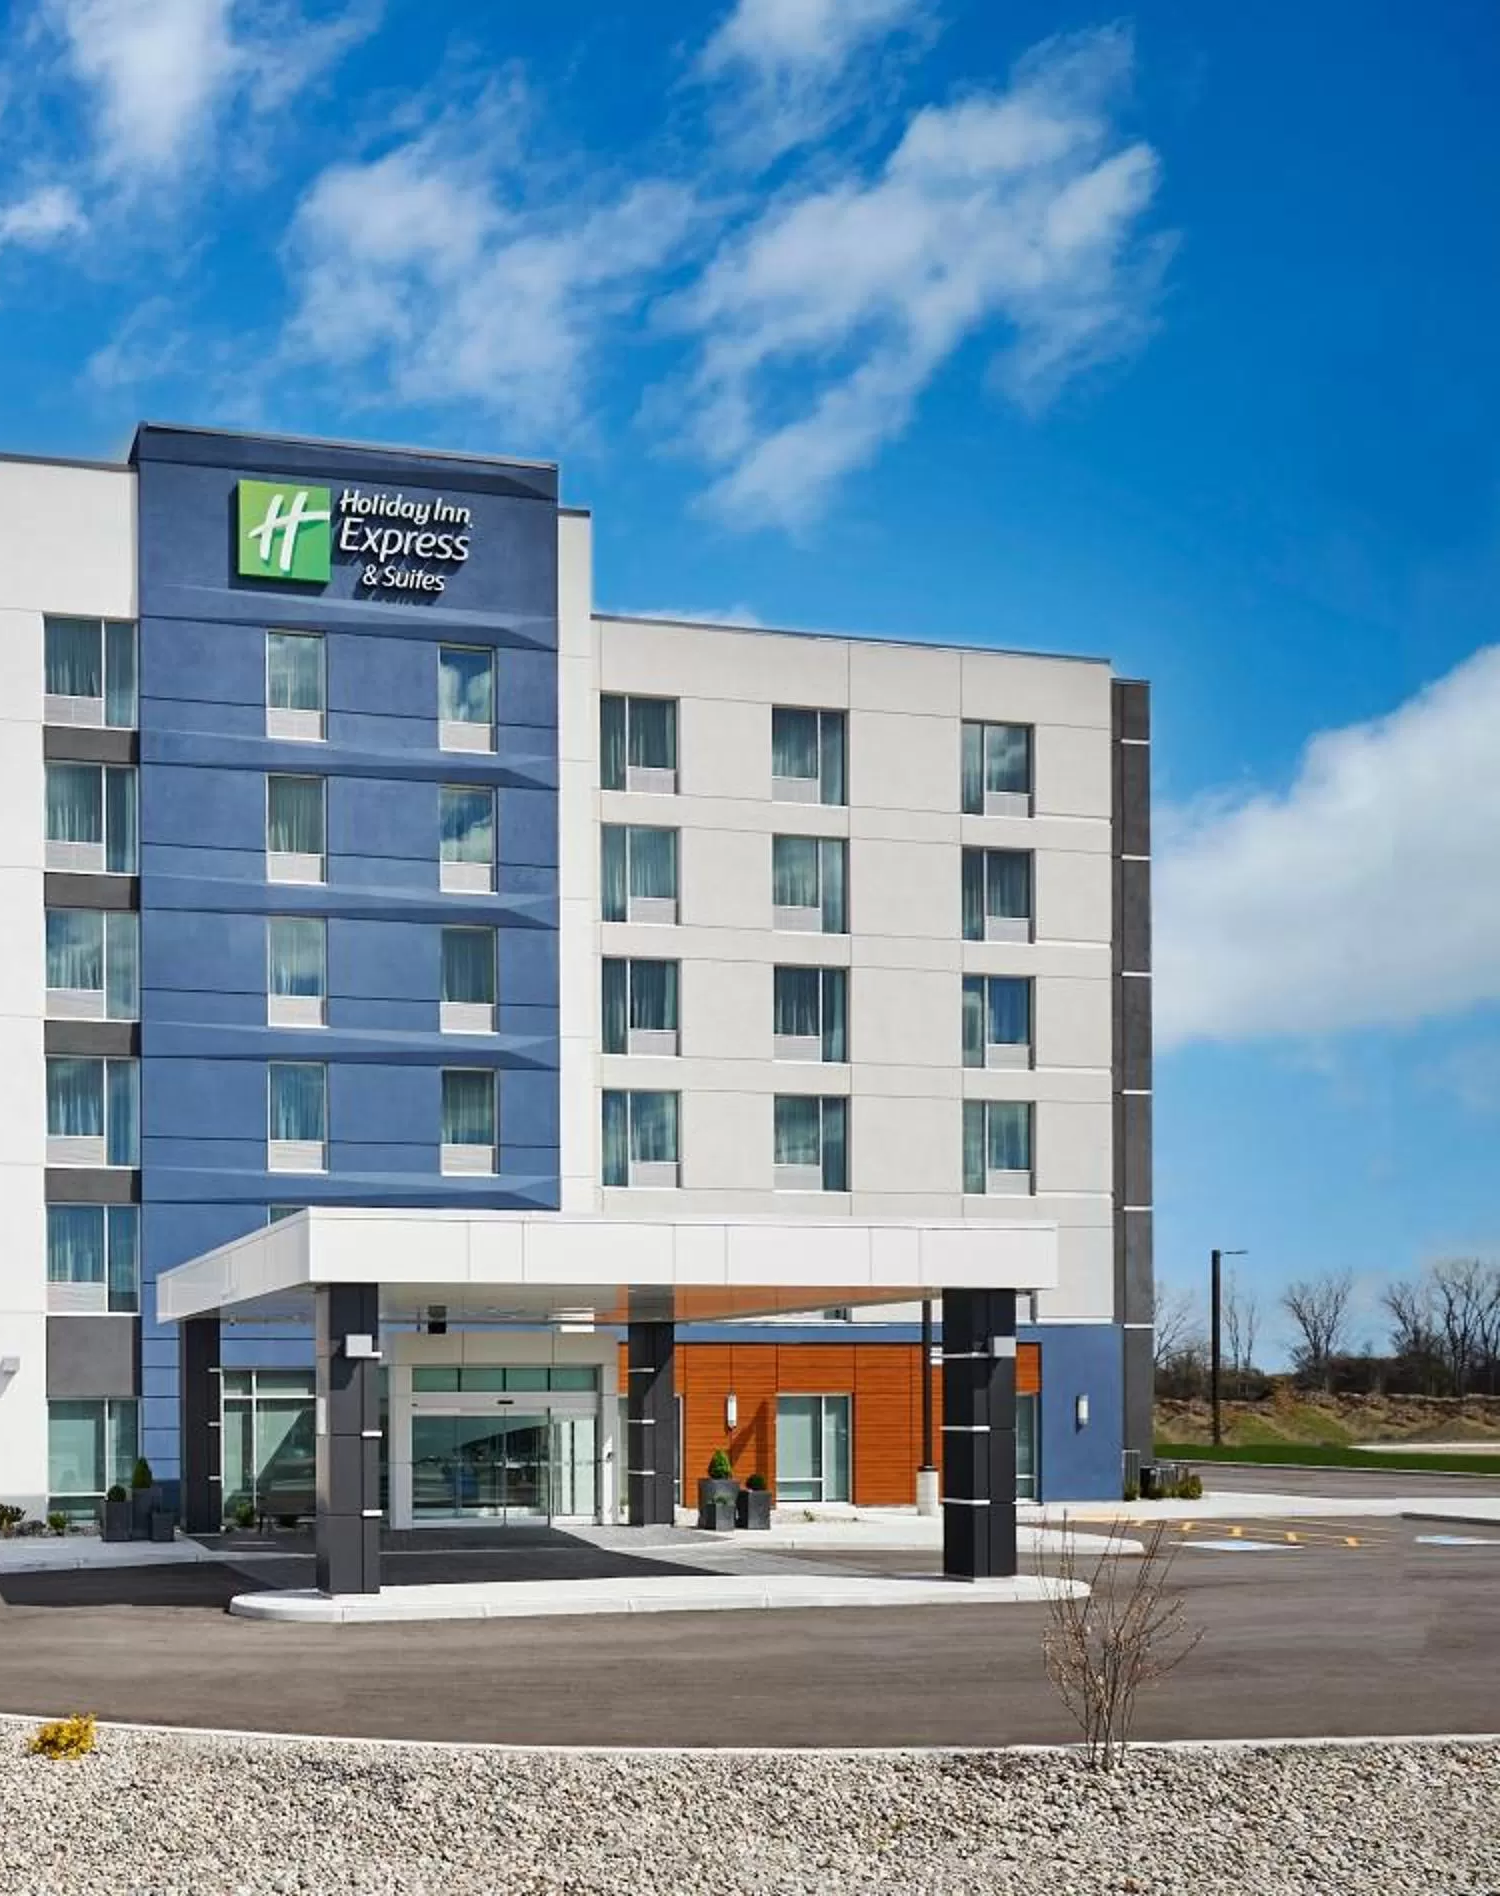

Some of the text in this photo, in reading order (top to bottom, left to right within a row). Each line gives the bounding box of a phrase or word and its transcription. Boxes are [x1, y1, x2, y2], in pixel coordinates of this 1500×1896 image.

[339, 488, 432, 525] Holiday
[339, 517, 471, 562] Express
[362, 563, 445, 591] & Suites
